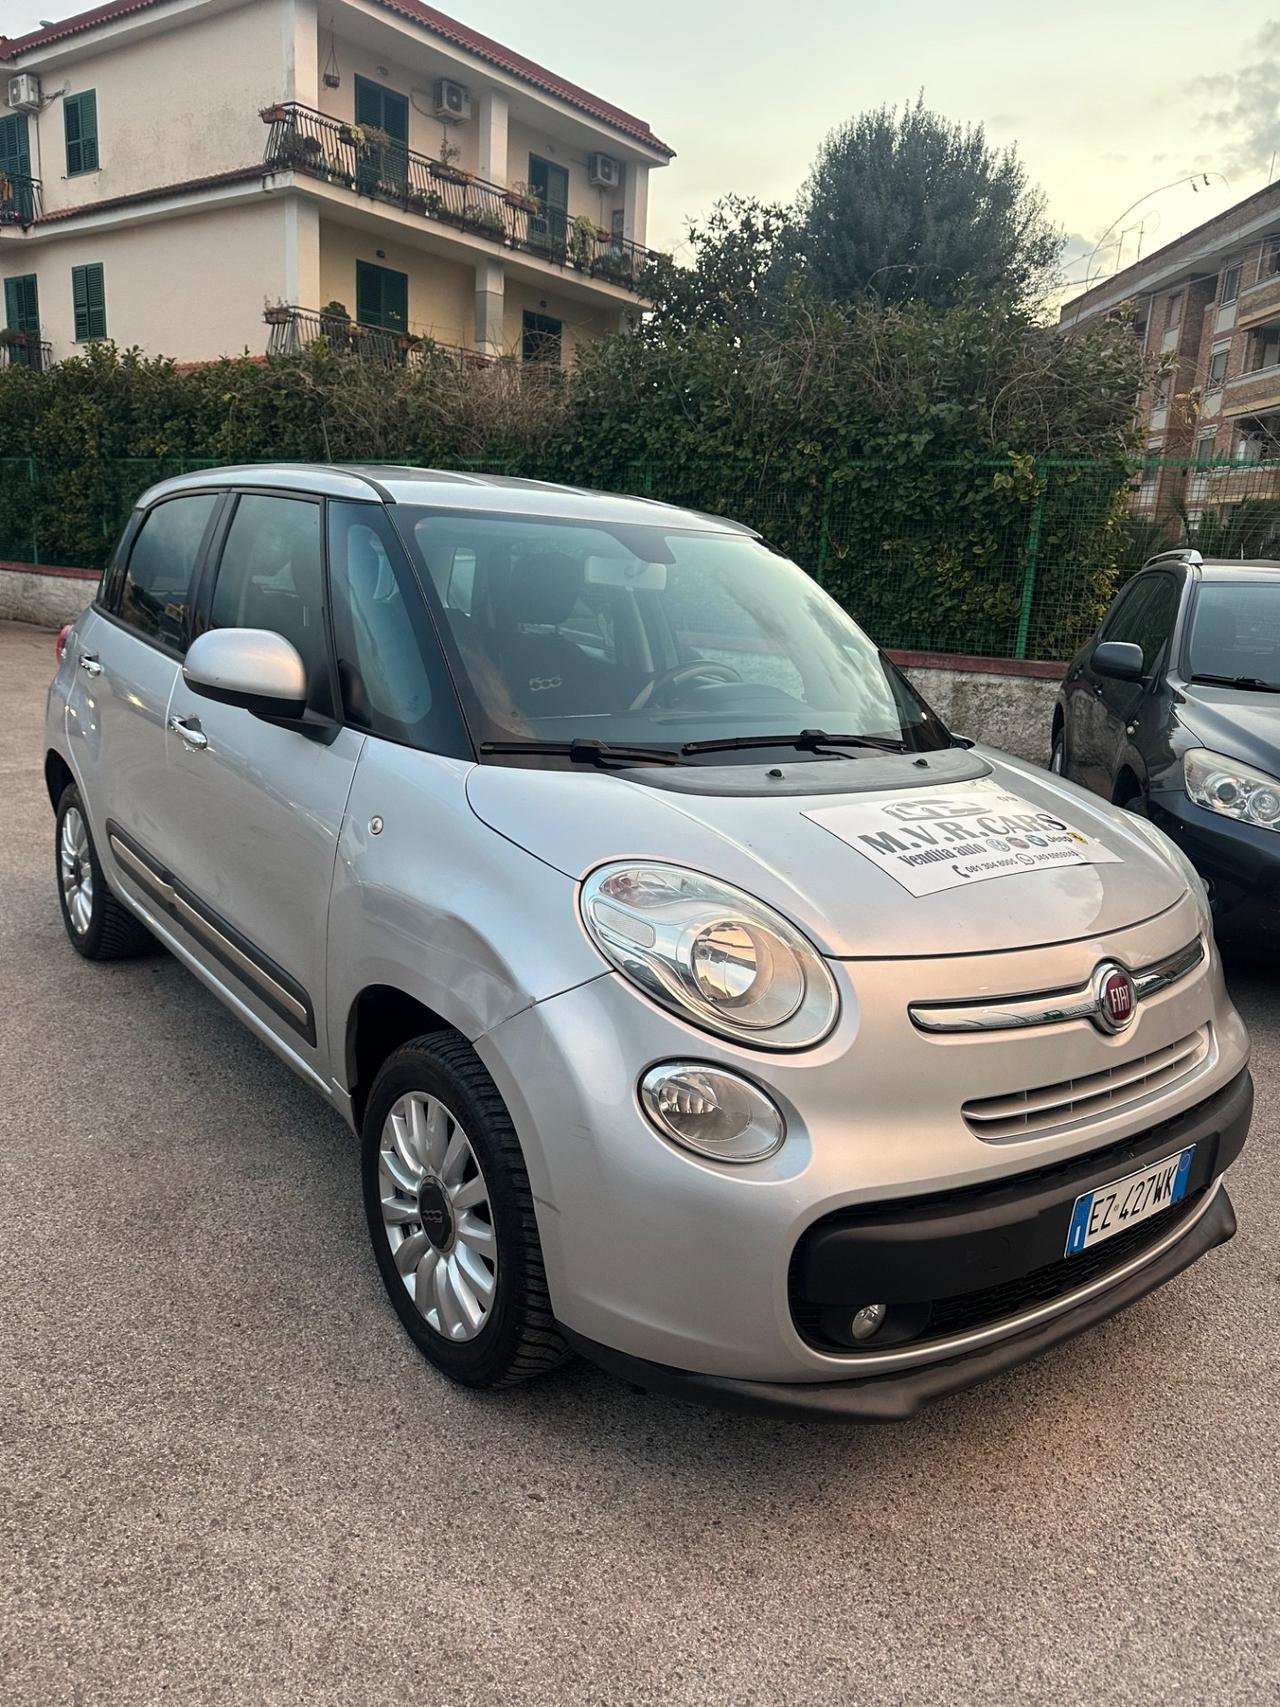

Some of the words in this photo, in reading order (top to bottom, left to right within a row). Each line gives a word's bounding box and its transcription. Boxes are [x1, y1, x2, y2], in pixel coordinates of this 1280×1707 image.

[897, 847, 957, 868] Vendita
[952, 843, 987, 858] auto
[1110, 984, 1130, 1013] FIAT
